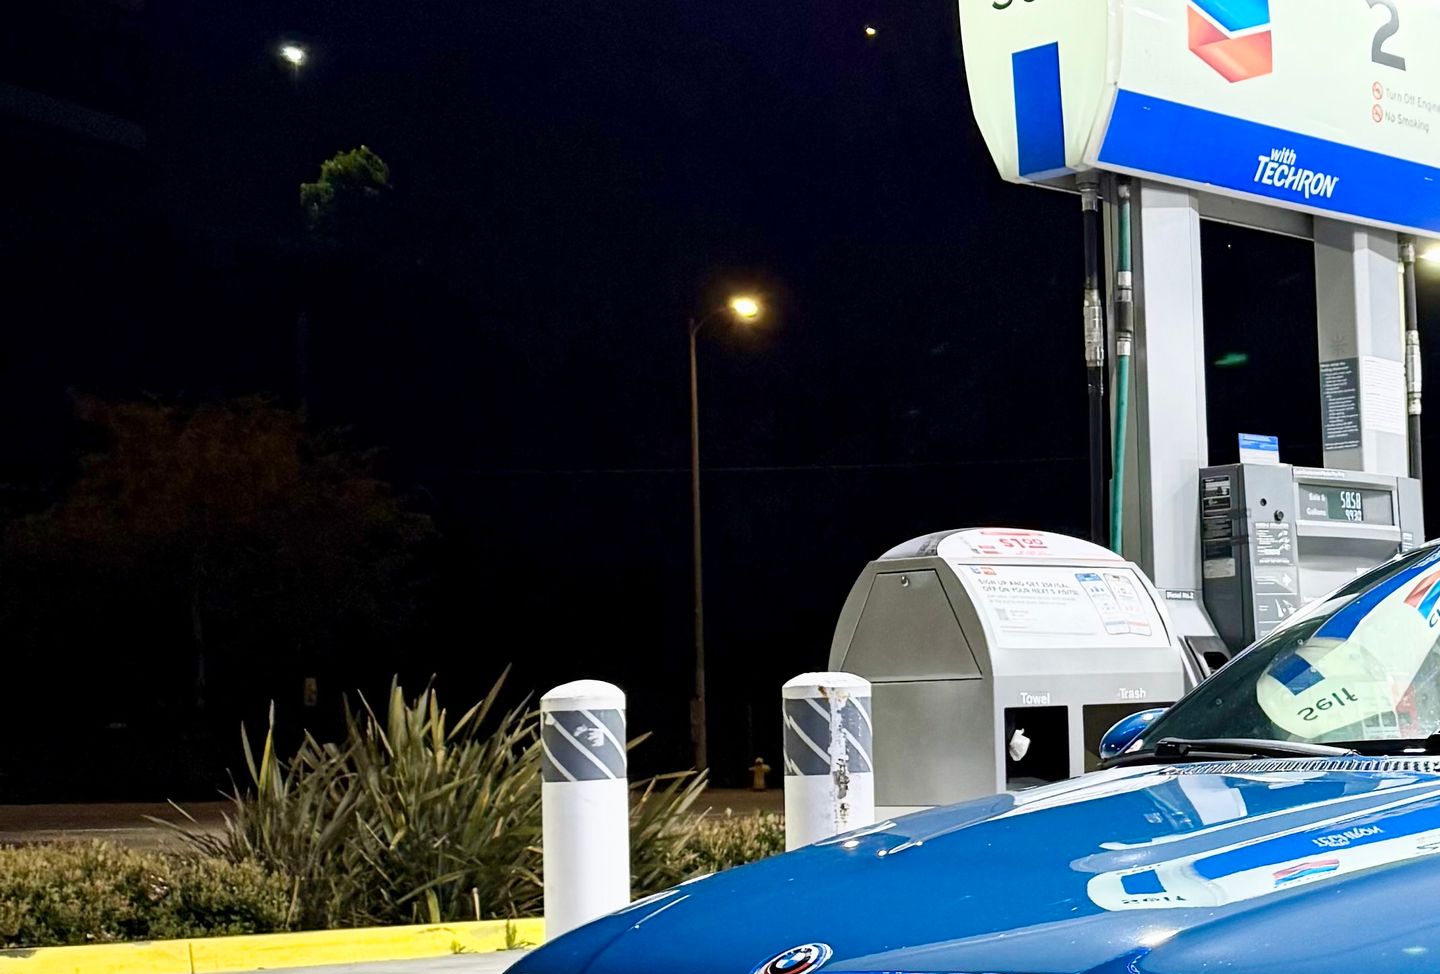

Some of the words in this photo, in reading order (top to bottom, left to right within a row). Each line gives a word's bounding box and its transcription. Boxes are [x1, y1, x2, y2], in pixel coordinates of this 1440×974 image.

[1366, 0, 1406, 71] 2
[1270, 147, 1297, 166] with
[1253, 155, 1338, 199] TECHRON
[1020, 692, 1050, 705] Towel
[1119, 688, 1146, 699] Trash
